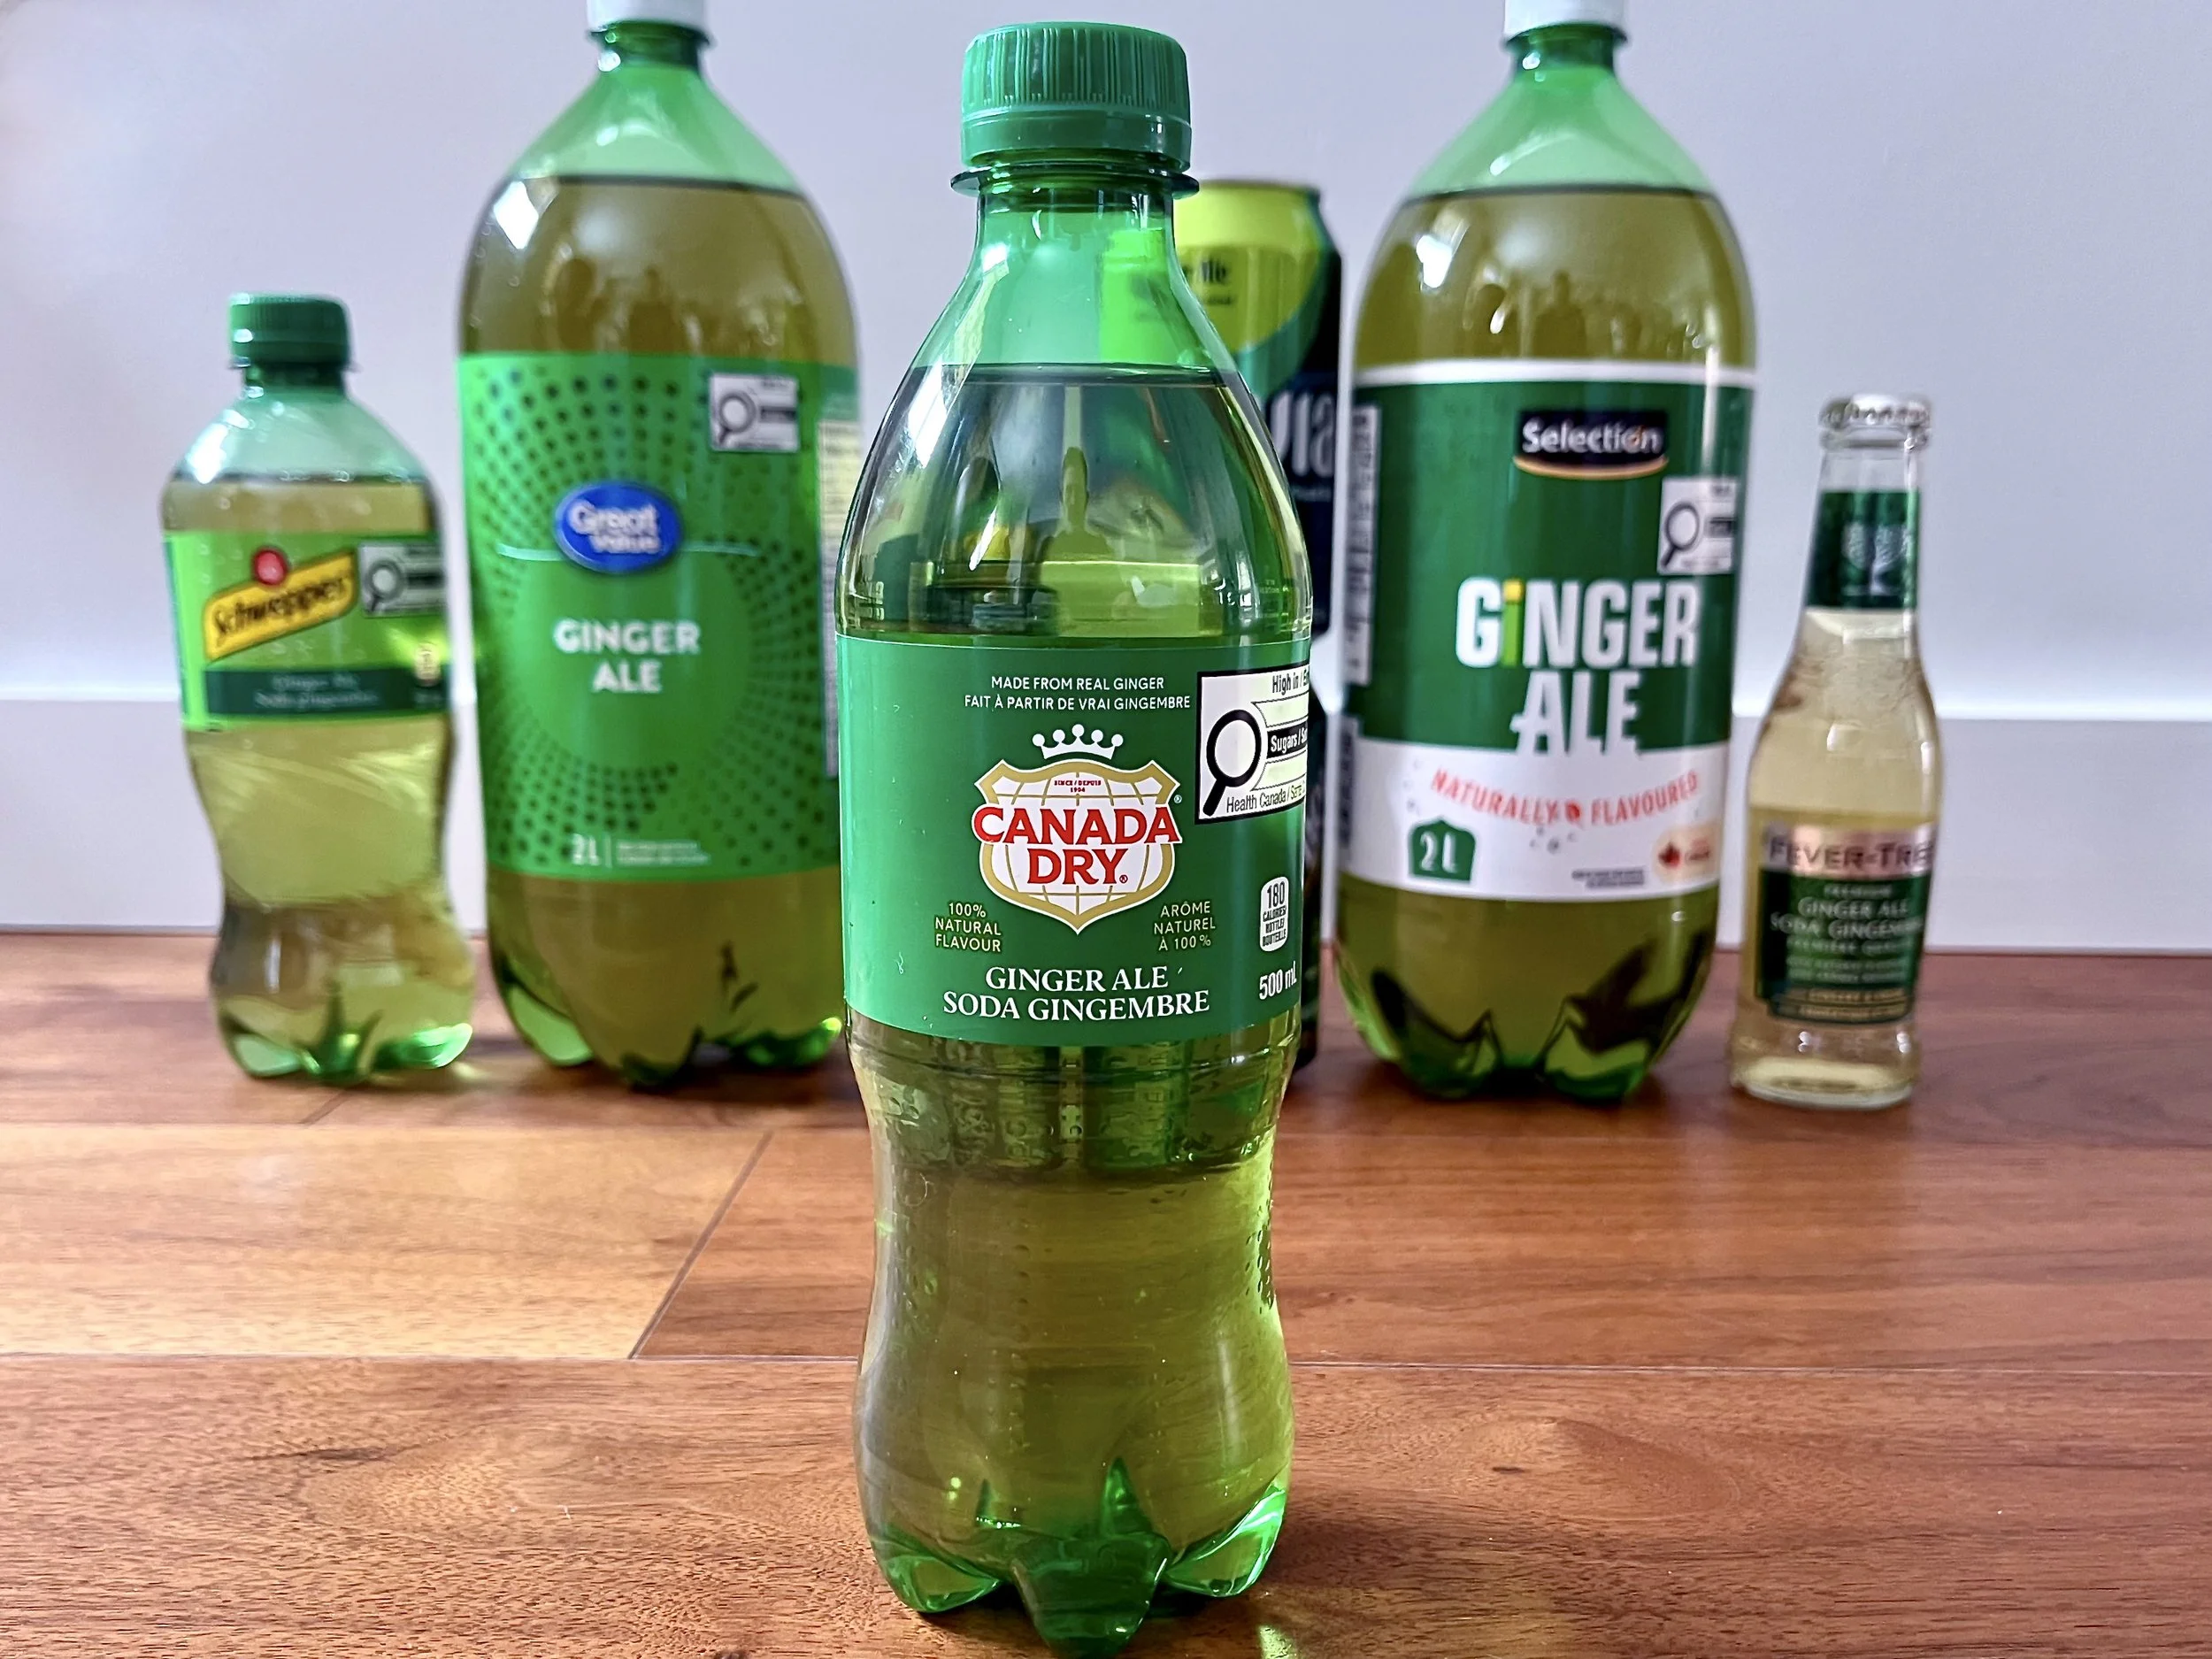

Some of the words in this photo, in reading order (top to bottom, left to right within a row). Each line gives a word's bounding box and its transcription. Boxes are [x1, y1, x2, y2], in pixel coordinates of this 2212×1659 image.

[1522, 417, 1663, 454] Selection
[553, 618, 702, 655] GINGER
[592, 661, 662, 694] ALE
[991, 676, 1030, 689] MADE
[1033, 677, 1072, 690] FROM
[1077, 678, 1110, 690] REAL
[1113, 677, 1164, 690] GINGER
[1272, 673, 1292, 696] High
[1293, 672, 1299, 689] in
[964, 695, 991, 708] FAIT
[995, 694, 1003, 709] À
[1007, 696, 1054, 710] PARTIR
[1057, 697, 1075, 710] DE
[1079, 698, 1110, 710] VRAI
[1114, 695, 1190, 710] GINGEMBRE
[1509, 671, 1643, 757] ALE
[1271, 733, 1297, 754] Sugars
[1226, 795, 1257, 813] Health
[1259, 787, 1286, 808] Canada
[1431, 767, 1559, 826] NATURALLY
[1590, 769, 1699, 826] FLAVOURED
[973, 806, 1181, 845] CANADA
[1026, 848, 1129, 885] DRY
[1267, 880, 1286, 909] 180
[949, 902, 987, 918] 100%
[1160, 901, 1210, 918] ARÔME
[935, 917, 1002, 936] NATURAL
[1154, 917, 1217, 935] NATUREL
[936, 933, 1002, 952] FLAVOUR
[1158, 936, 1169, 951] À
[986, 966, 1107, 993] GINGER
[1111, 965, 1170, 990] ALE
[1259, 969, 1283, 1000] 500
[1285, 960, 1297, 989] mL
[943, 990, 1020, 1019] SODA
[1027, 989, 1210, 1021] GINGEMBRE
